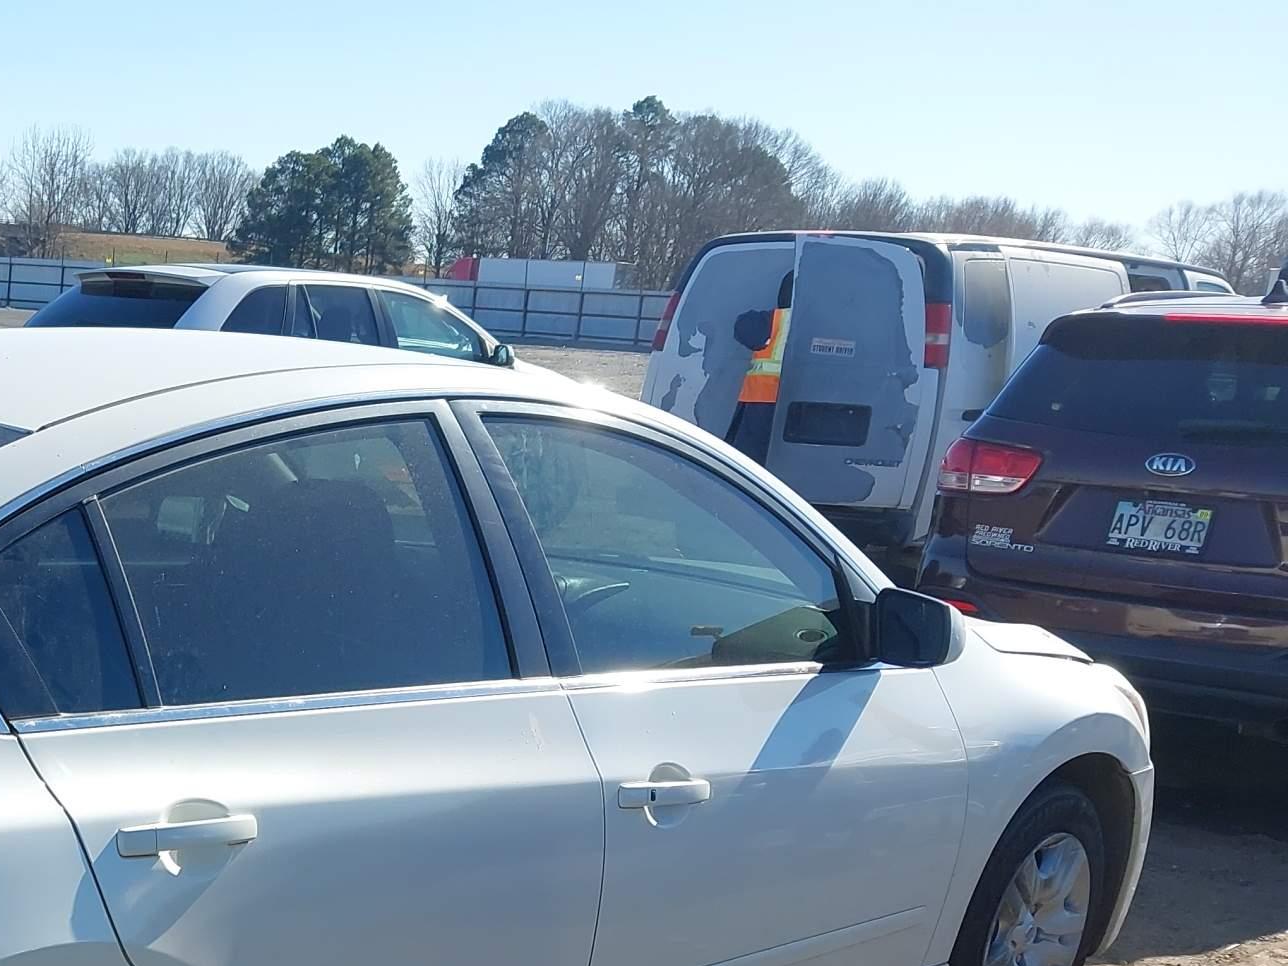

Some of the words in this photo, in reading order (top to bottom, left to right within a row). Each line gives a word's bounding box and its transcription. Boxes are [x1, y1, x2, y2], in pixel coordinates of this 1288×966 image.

[1152, 456, 1186, 472] KIA
[1111, 513, 1154, 537] APV
[1164, 519, 1206, 543] 68R
